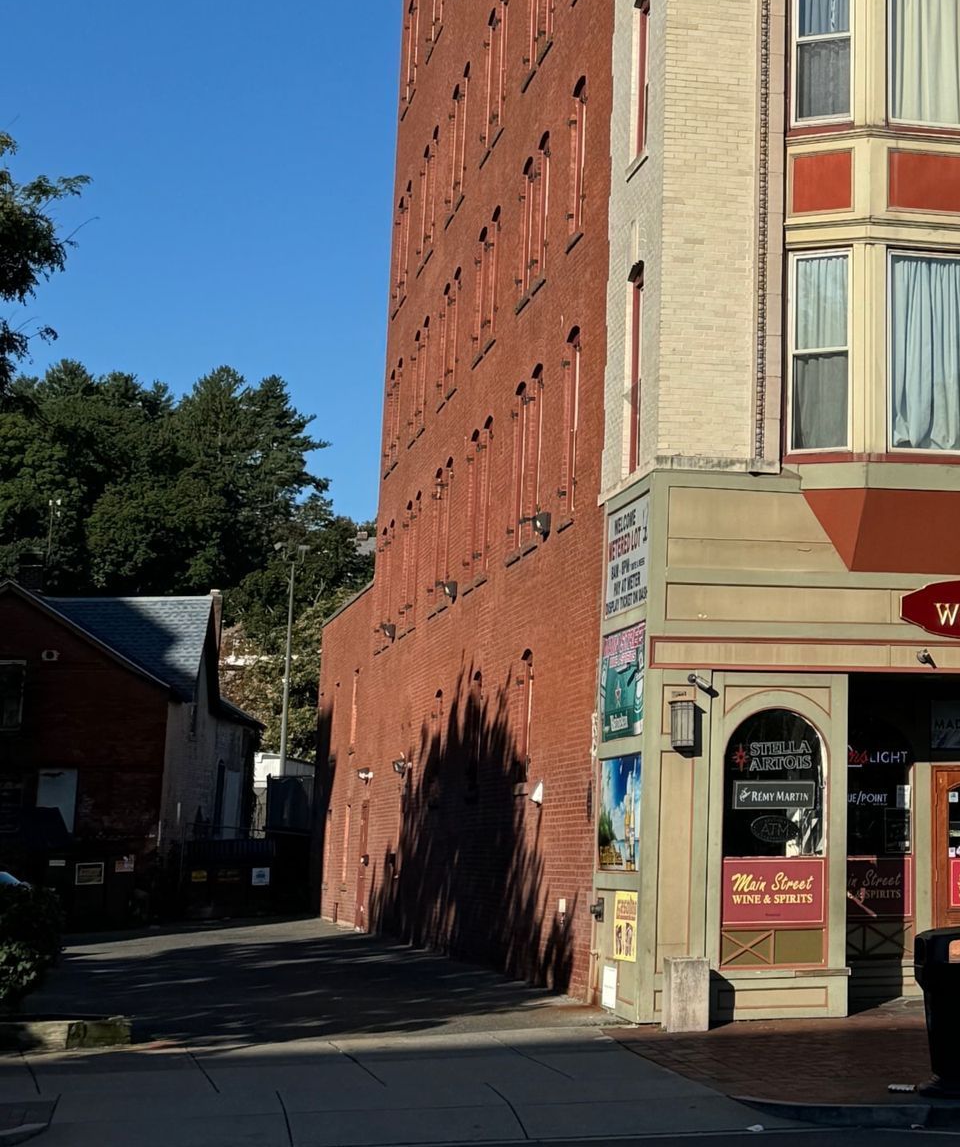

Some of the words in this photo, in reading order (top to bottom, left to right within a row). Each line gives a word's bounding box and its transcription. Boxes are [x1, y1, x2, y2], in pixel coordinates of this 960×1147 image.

[614, 509, 636, 536] WELCOME
[608, 532, 630, 563] METERED
[631, 525, 642, 551] LOT
[627, 571, 641, 591] METER
[620, 593, 633, 611] TICKET
[749, 740, 812, 756] STELLA
[749, 755, 812, 772] ARTOIS
[869, 751, 908, 763] LIGHT
[751, 790, 775, 802] RÉMY
[761, 822, 789, 837] ATM
[731, 873, 765, 893] Main
[771, 871, 814, 892] Street
[862, 868, 902, 887] Street
[732, 895, 761, 905] WINE
[763, 894, 771, 904] &
[773, 893, 813, 904] SPIRITS
[865, 888, 902, 899] SPIRITS
